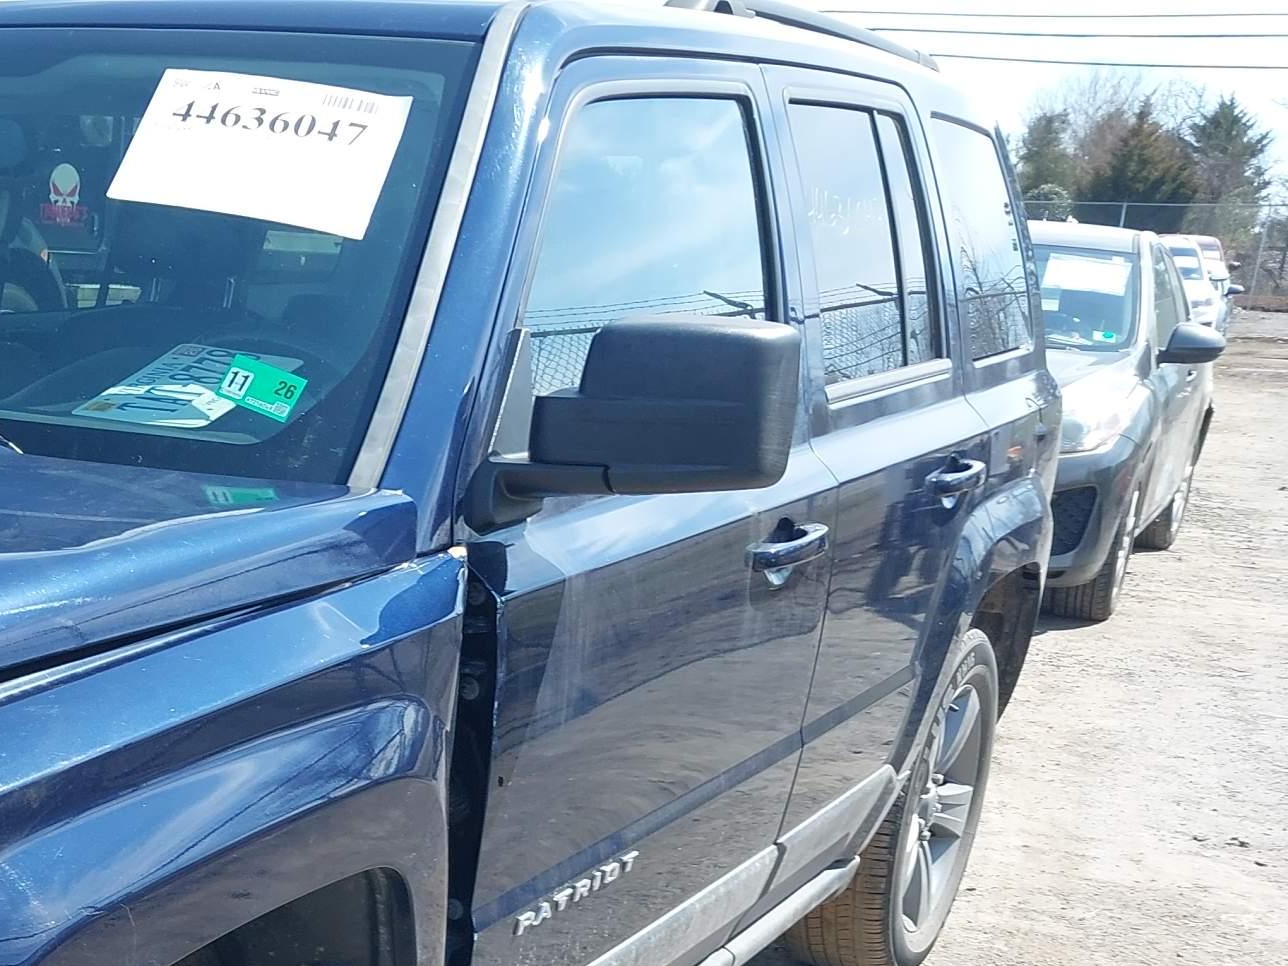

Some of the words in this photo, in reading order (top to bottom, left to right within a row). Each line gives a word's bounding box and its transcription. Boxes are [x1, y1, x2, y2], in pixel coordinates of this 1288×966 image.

[172, 101, 368, 145] 44636047
[227, 370, 251, 392] 11
[274, 381, 297, 400] 26
[513, 851, 640, 936] PATRIOT
